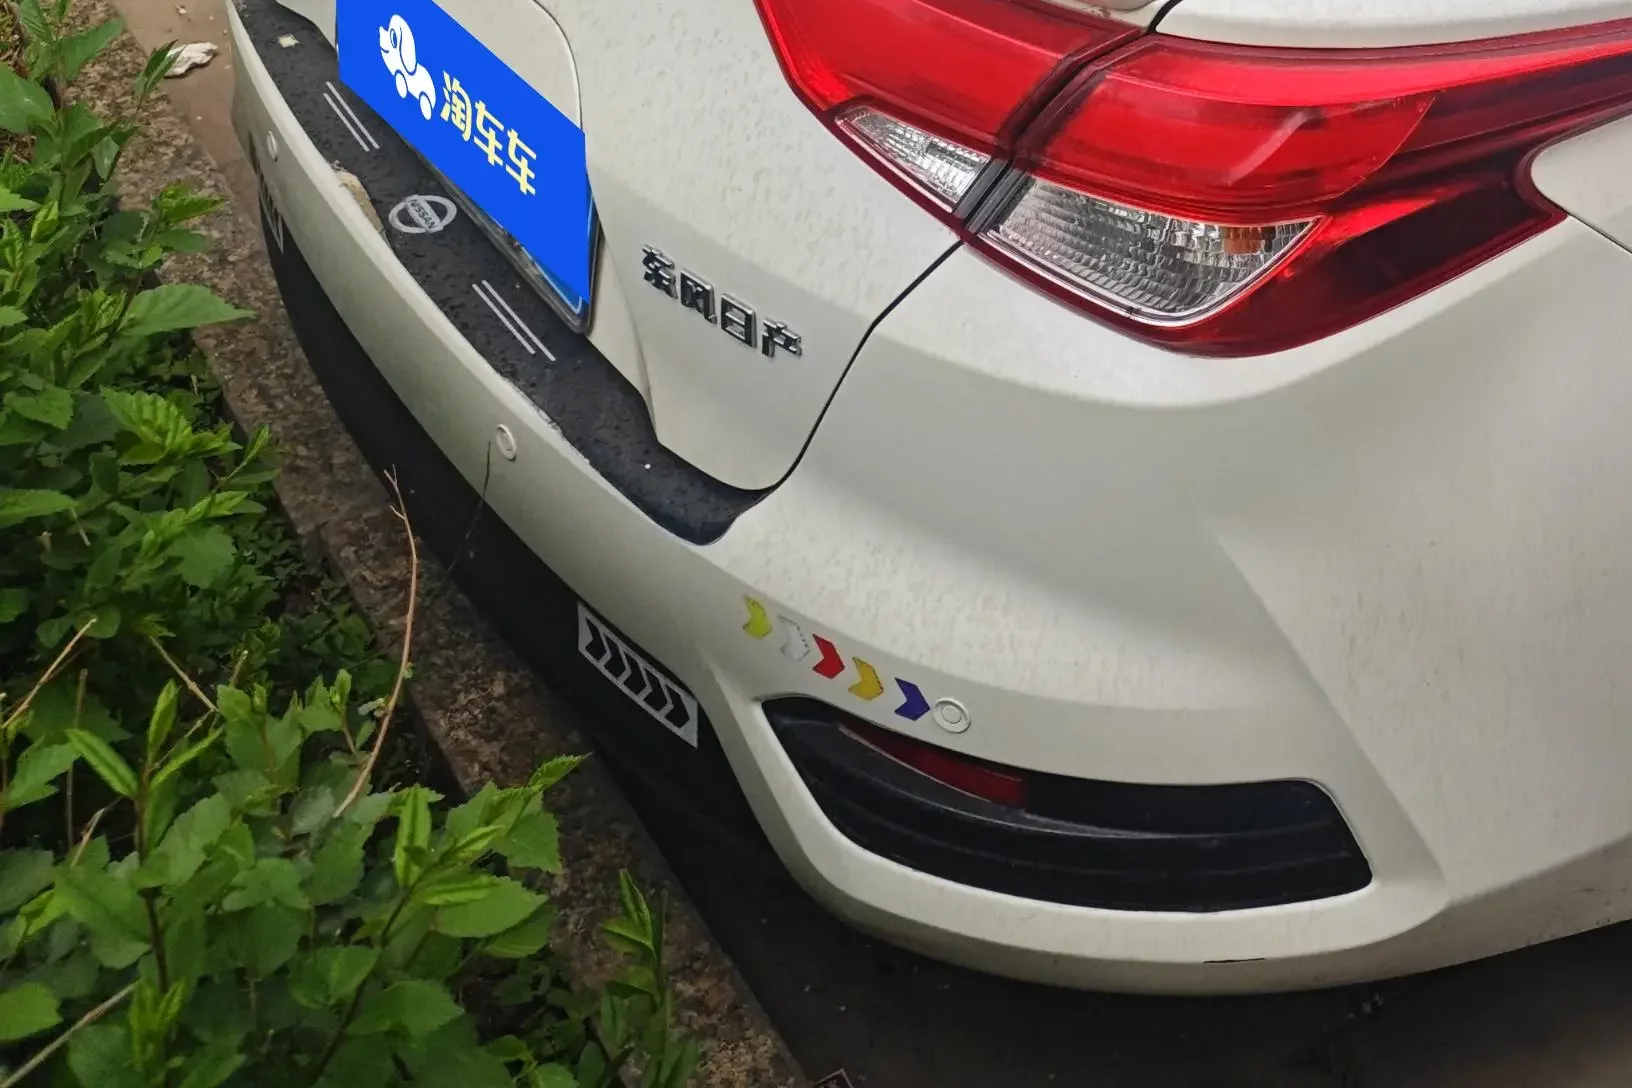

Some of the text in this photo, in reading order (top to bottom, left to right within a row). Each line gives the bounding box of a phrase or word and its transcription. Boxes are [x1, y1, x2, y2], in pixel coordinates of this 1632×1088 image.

[407, 198, 436, 230] NISSAN
[642, 244, 803, 358] 东风日产
